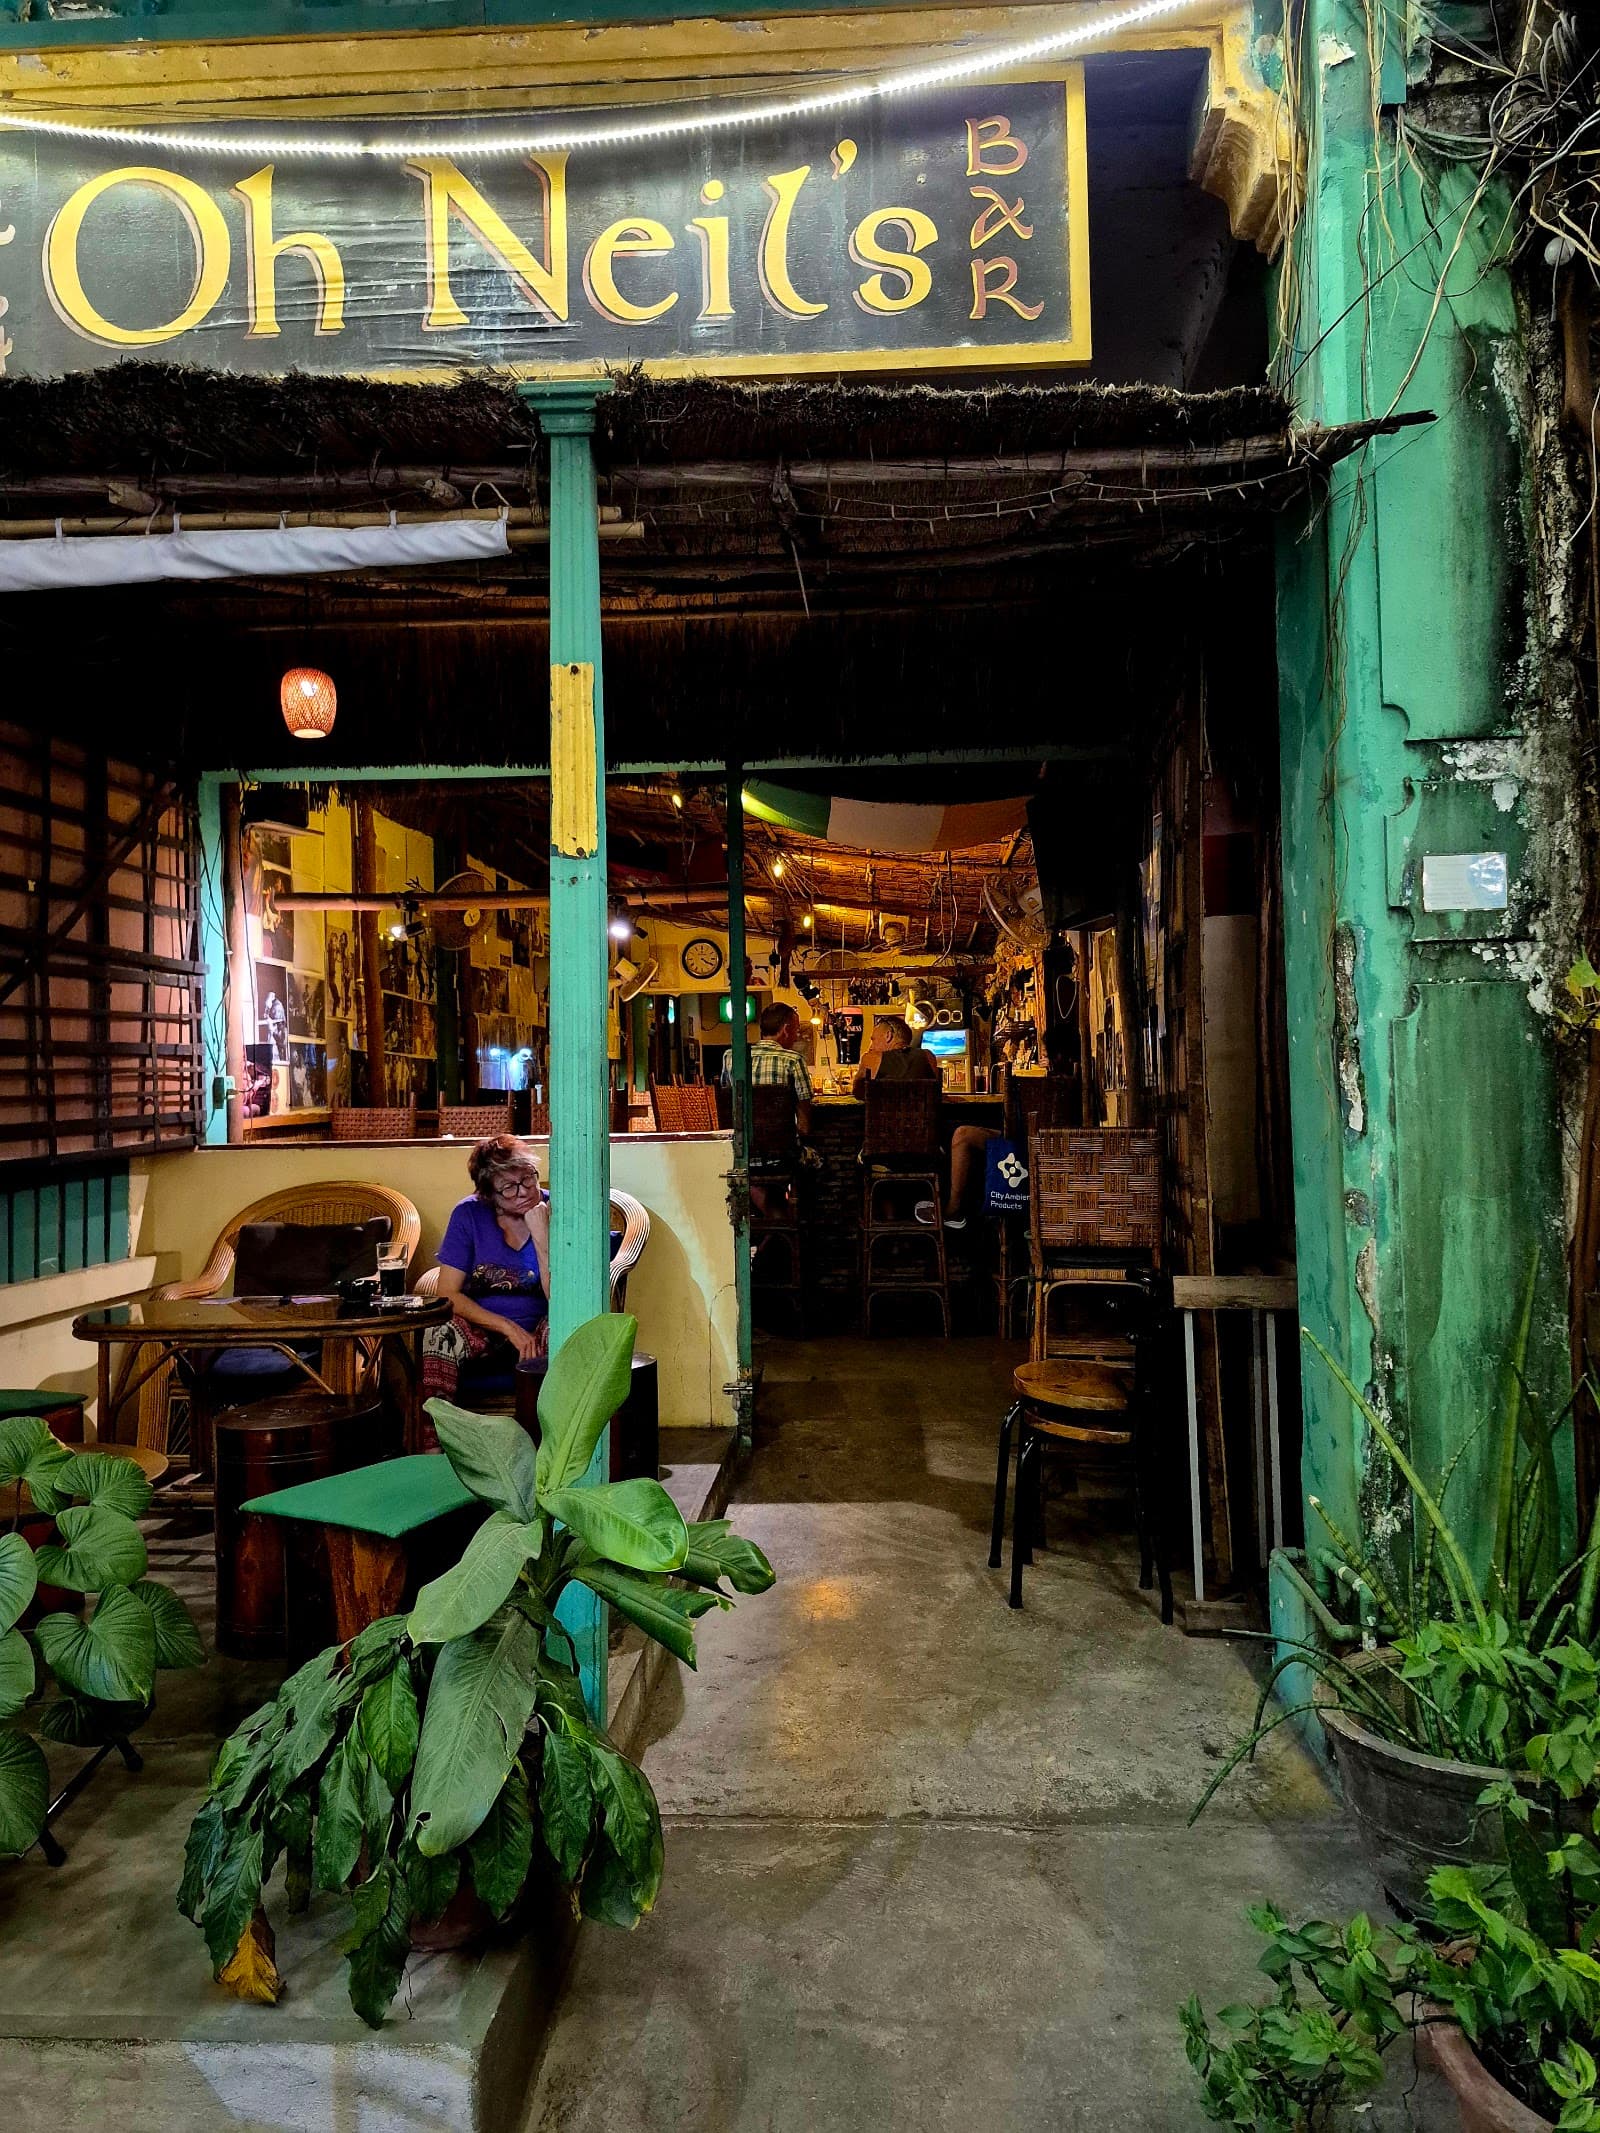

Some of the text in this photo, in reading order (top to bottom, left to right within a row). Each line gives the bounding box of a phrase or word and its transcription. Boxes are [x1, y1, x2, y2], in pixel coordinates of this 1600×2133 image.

[42, 163, 347, 348] Oh
[403, 139, 938, 326] Neil's
[964, 115, 1045, 321] BAR
[990, 1191, 1004, 1200] City
[990, 1200, 1022, 1210] Products
